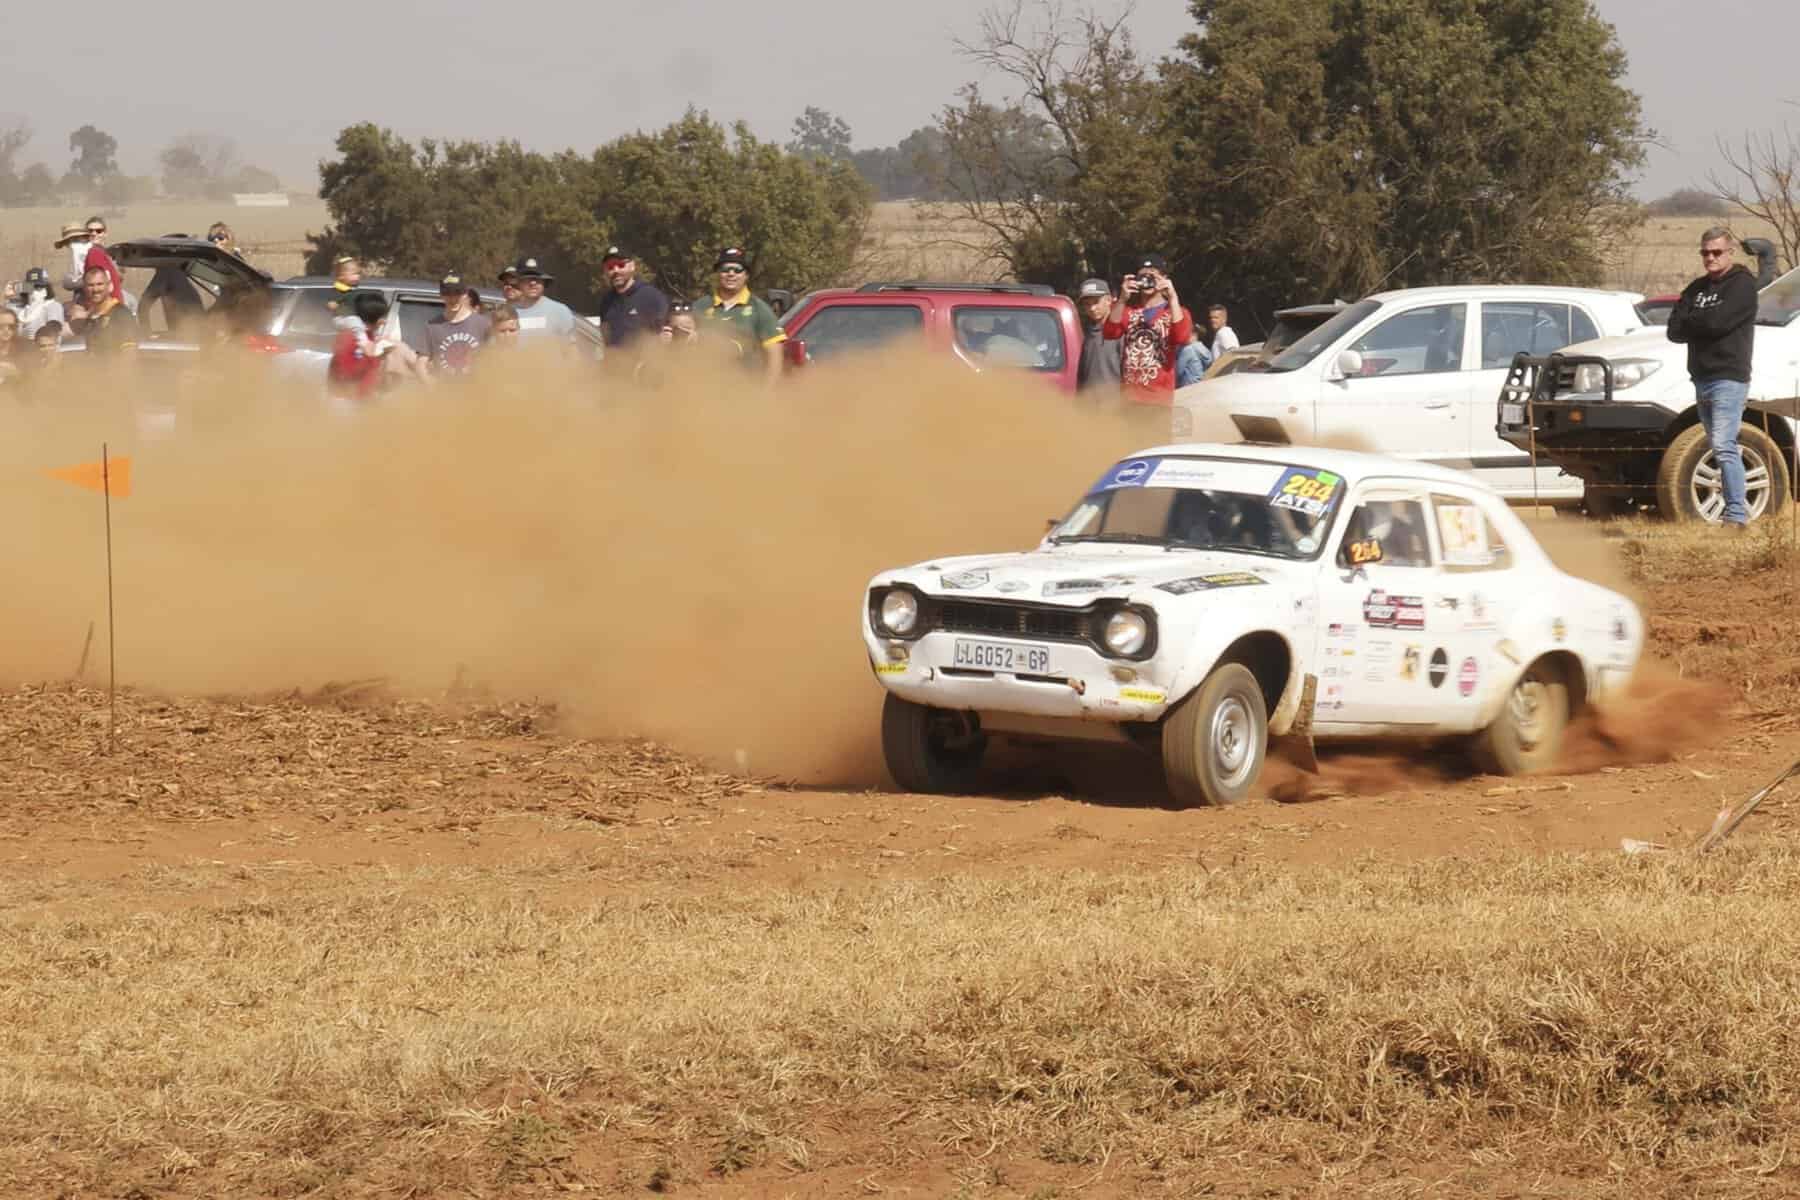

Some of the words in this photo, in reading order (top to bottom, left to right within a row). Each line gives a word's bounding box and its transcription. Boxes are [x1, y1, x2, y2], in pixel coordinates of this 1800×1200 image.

[1283, 474, 1333, 504] 264
[955, 642, 1013, 669] LLG052
[1028, 649, 1048, 672] GP
